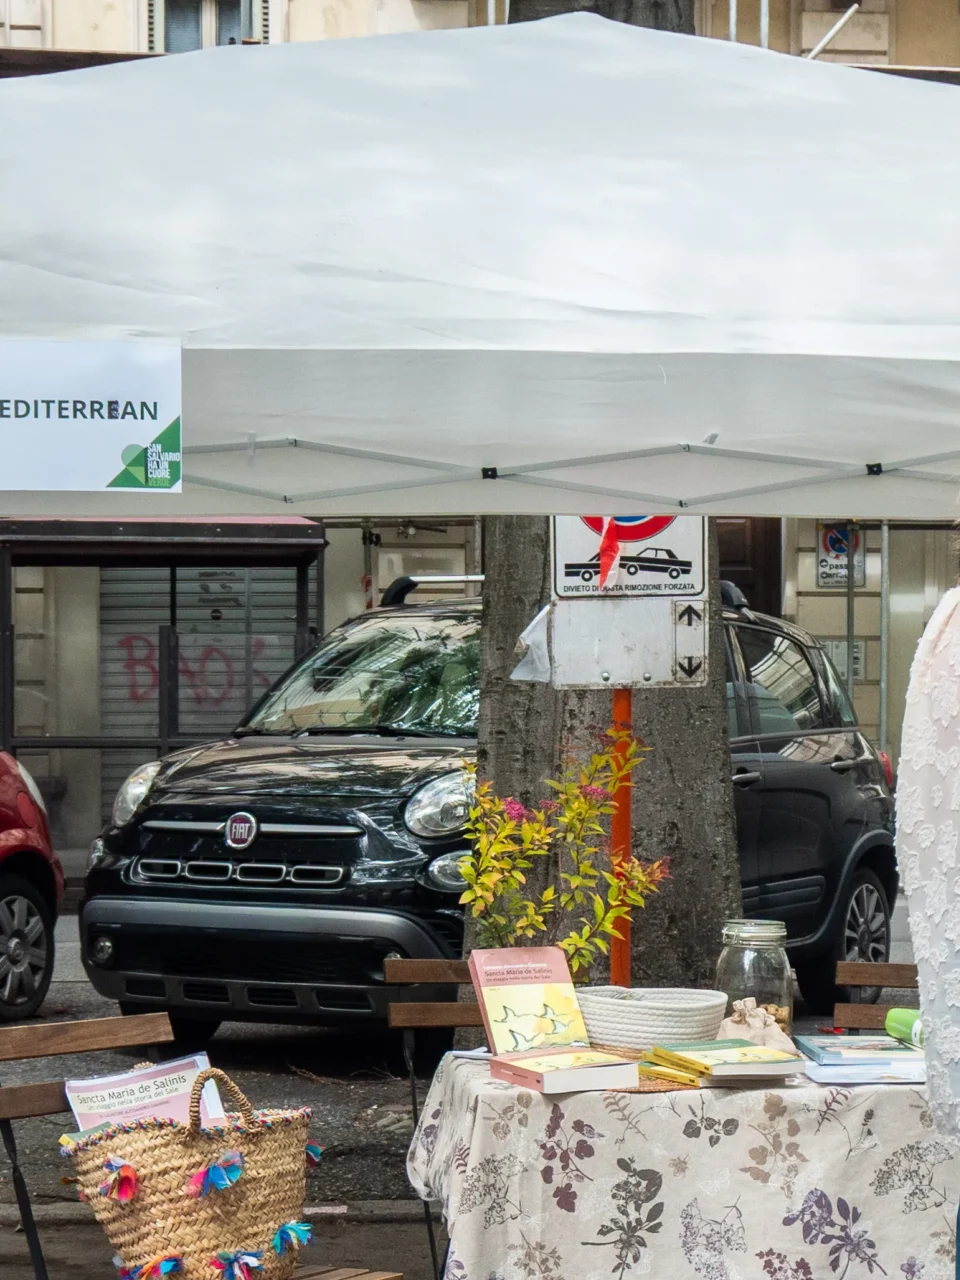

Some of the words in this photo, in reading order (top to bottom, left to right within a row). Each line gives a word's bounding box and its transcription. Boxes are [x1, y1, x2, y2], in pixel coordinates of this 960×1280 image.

[147, 444, 162, 452] SAN
[147, 452, 180, 461] SALVARIO
[148, 461, 158, 469] HA
[159, 461, 169, 469] UN
[148, 469, 171, 478] CUORE
[563, 584, 591, 592] DIVIETO
[592, 584, 599, 592] DI
[624, 583, 662, 591] RIMOZIONE
[231, 823, 250, 838] FIAT
[76, 1093, 106, 1105] Sancta
[108, 1087, 135, 1100] Maria
[138, 1083, 151, 1094] de
[117, 1097, 133, 1106] nella
[134, 1093, 153, 1102] storia
[154, 1089, 164, 1097] del
[165, 1086, 179, 1095] Sale
